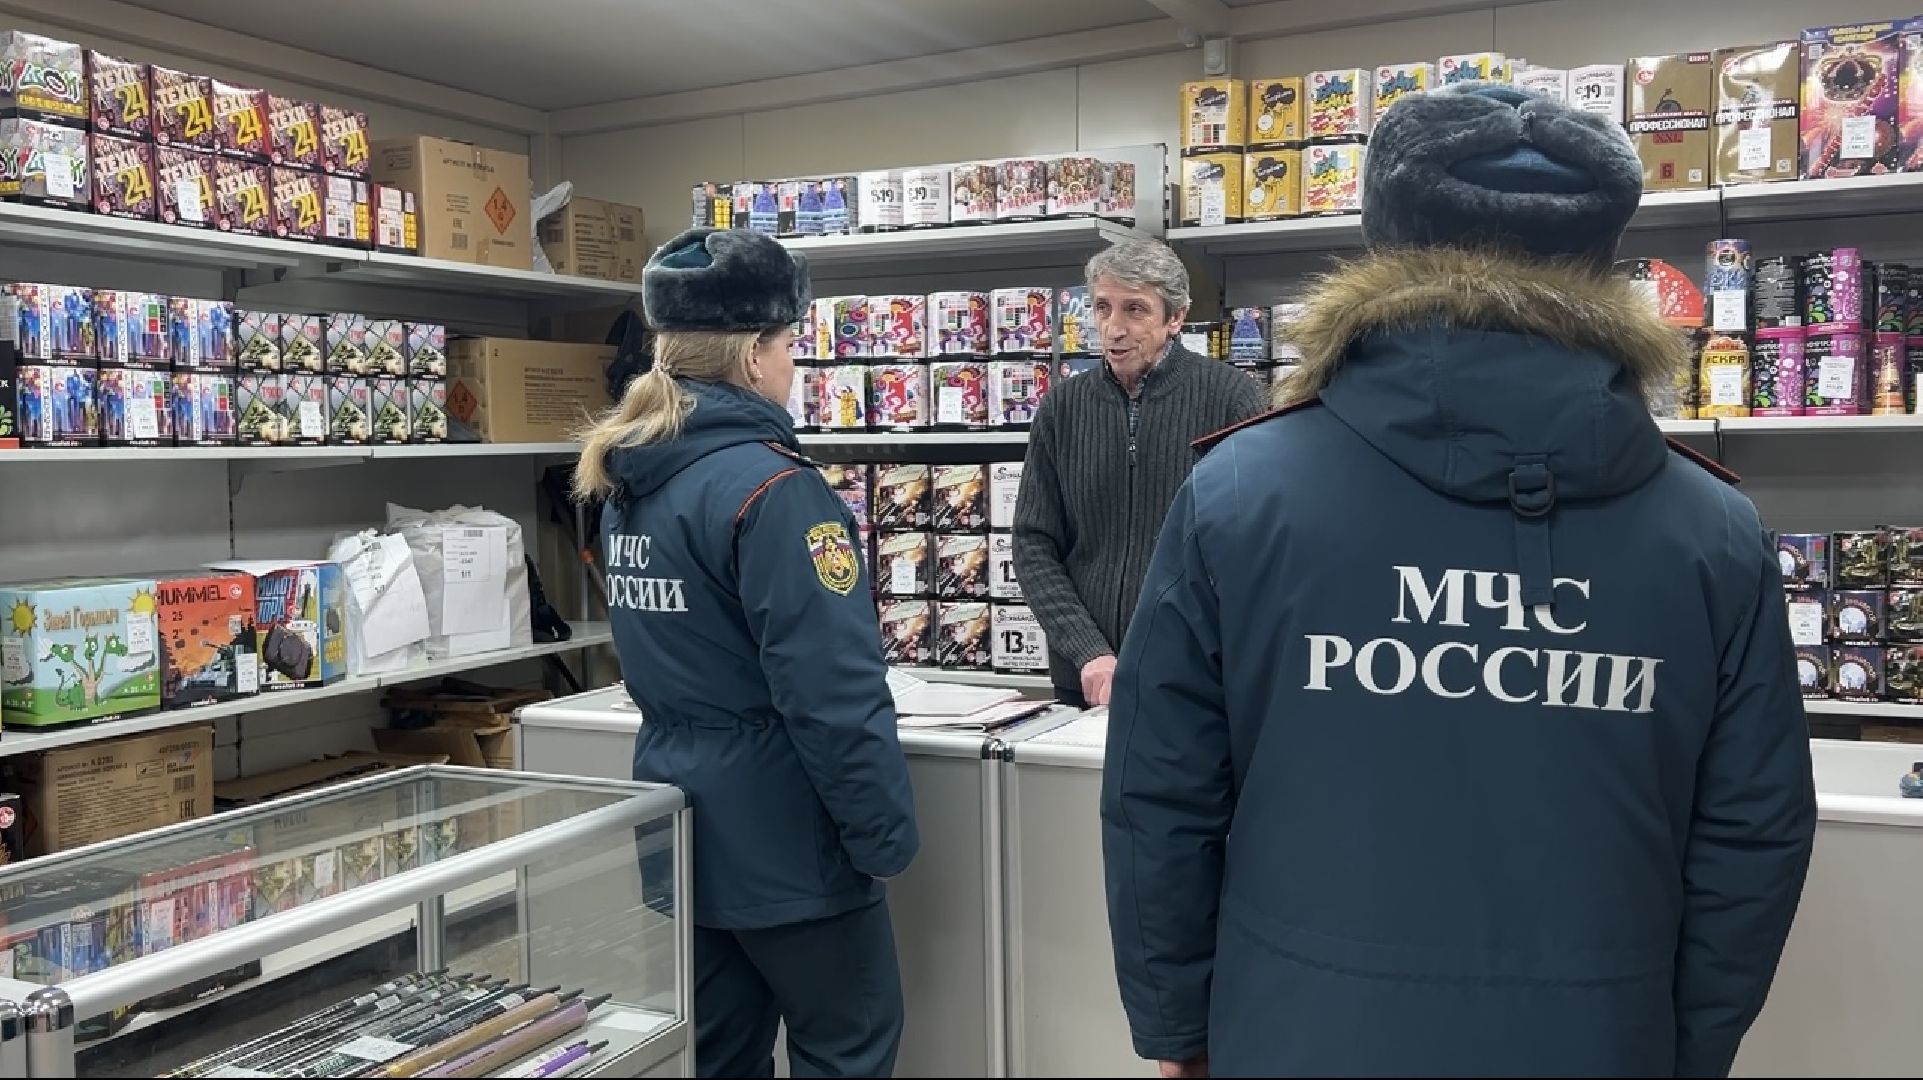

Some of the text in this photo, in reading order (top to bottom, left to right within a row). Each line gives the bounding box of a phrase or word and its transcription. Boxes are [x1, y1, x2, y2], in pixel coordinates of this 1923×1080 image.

[115, 82, 149, 122] 24
[177, 97, 213, 137] 24
[229, 106, 263, 145] 24
[287, 119, 318, 157] 24
[1629, 118, 1707, 133] ПРОФЕССИОНАЛ
[339, 130, 369, 166] 24
[117, 163, 151, 206] 24
[236, 186, 269, 223] 24
[292, 191, 321, 229] 24
[608, 533, 652, 569] МЧС
[607, 573, 688, 612] ОССИИ
[1391, 565, 1590, 634] МЧС
[172, 611, 183, 621] 25
[1000, 629, 1024, 655] 13
[1303, 634, 1664, 713] РОССИИ
